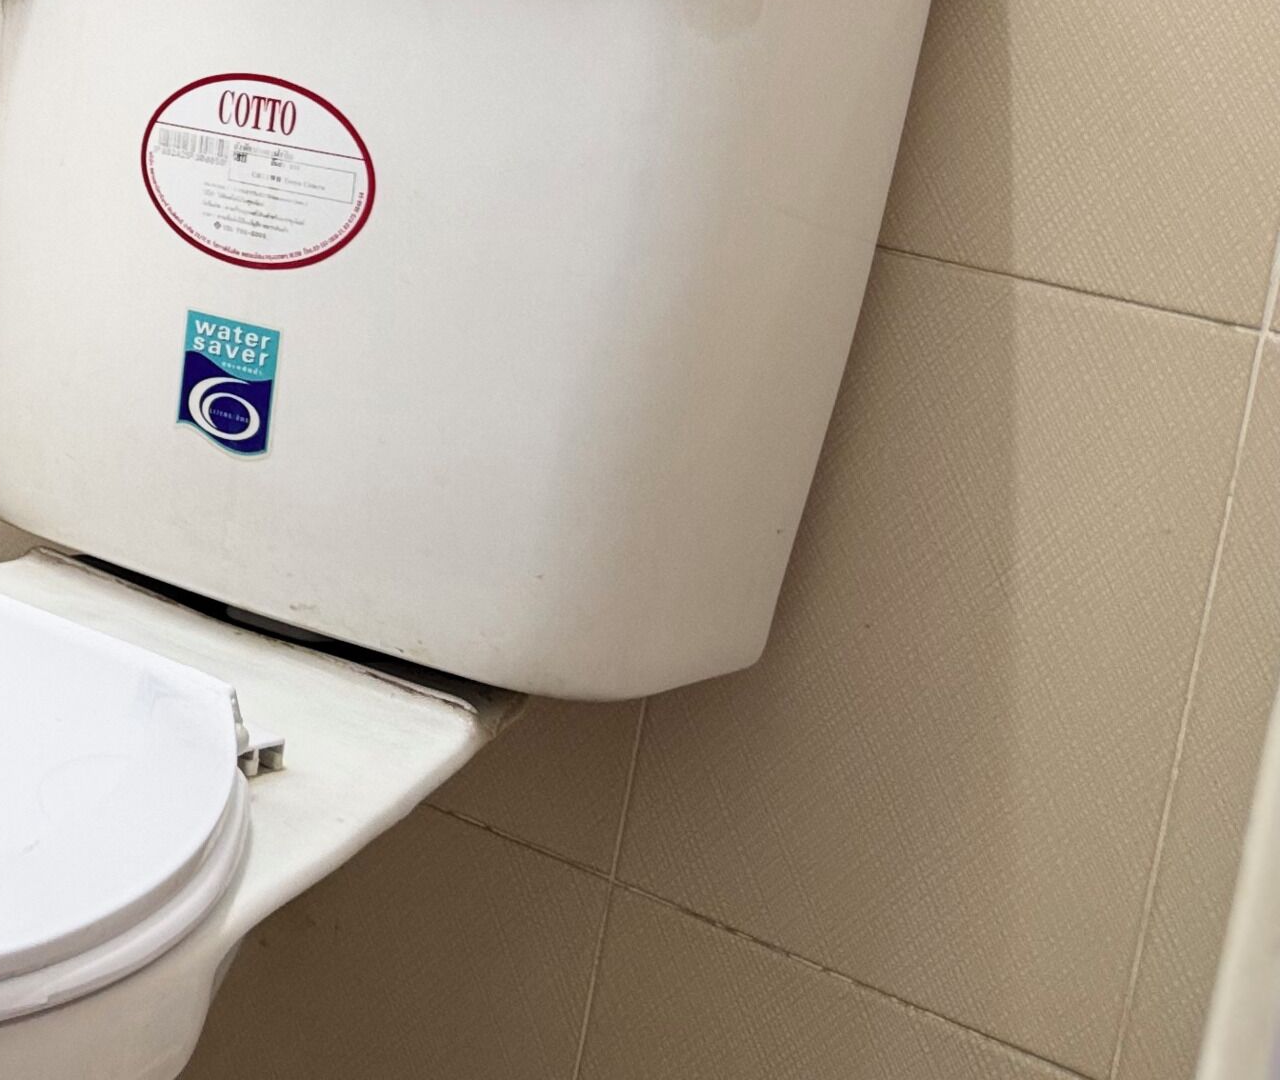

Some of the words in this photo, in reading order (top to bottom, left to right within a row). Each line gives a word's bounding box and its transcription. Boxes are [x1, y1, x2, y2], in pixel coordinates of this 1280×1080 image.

[219, 89, 297, 136] COTTO
[194, 319, 271, 350] water
[193, 336, 270, 366] saver
